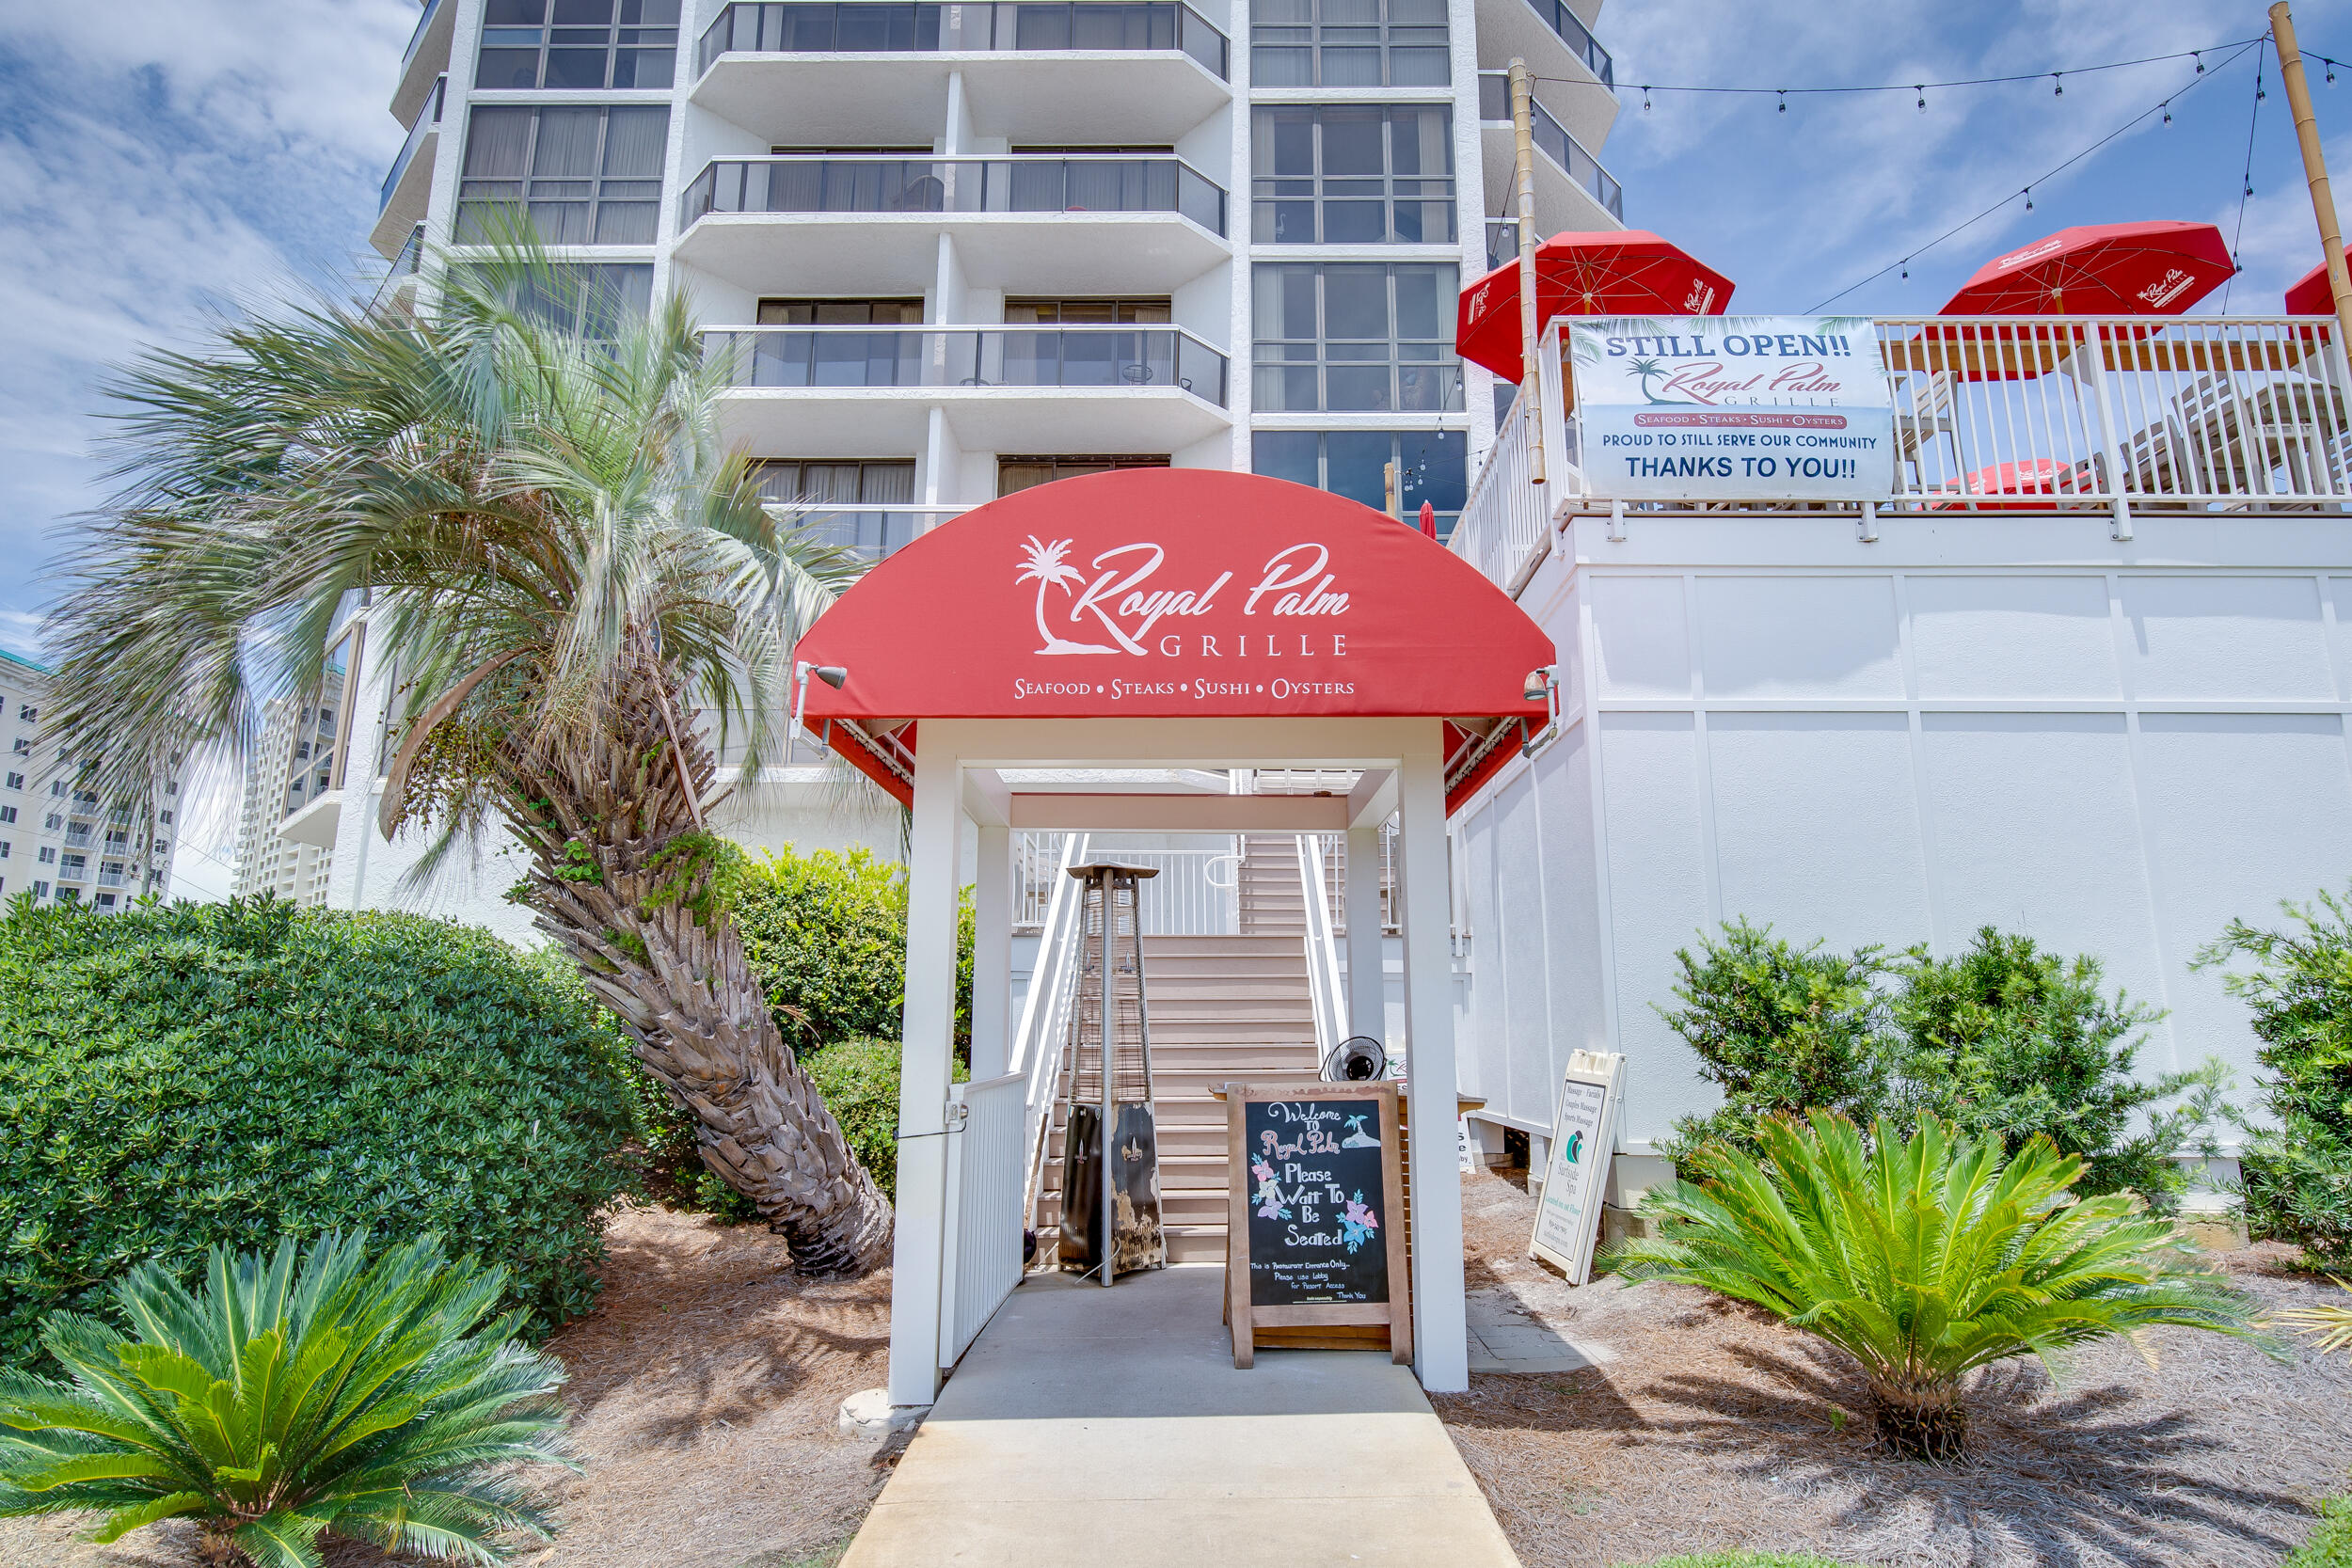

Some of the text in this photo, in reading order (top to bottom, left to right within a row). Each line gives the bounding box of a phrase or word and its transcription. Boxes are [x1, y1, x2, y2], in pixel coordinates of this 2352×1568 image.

[1606, 335, 1851, 356] STILL OPEN!!
[1661, 361, 1842, 406] Royal Palm
[1724, 396, 1841, 407] GRILLE
[1603, 434, 1877, 450] PROUD TO STILL SERVE OUR COMMUNITY
[1626, 457, 1855, 479] THANKS TO YOU!!
[1070, 542, 1350, 657] Royal Palm
[1160, 634, 1347, 657] GRILLE
[1268, 1101, 1342, 1123] Welcome
[1261, 1130, 1340, 1160] Royal Palm
[1285, 1163, 1332, 1183] Please
[1558, 1163, 1579, 1181] Surfside
[1274, 1183, 1345, 1206] Wait To
[1566, 1180, 1577, 1196] Spa
[1302, 1206, 1320, 1223] Be
[1284, 1225, 1343, 1245] Seated
[1274, 1272, 1294, 1281] Please
[1312, 1272, 1328, 1281] Lobby
[1291, 1281, 1300, 1290] for
